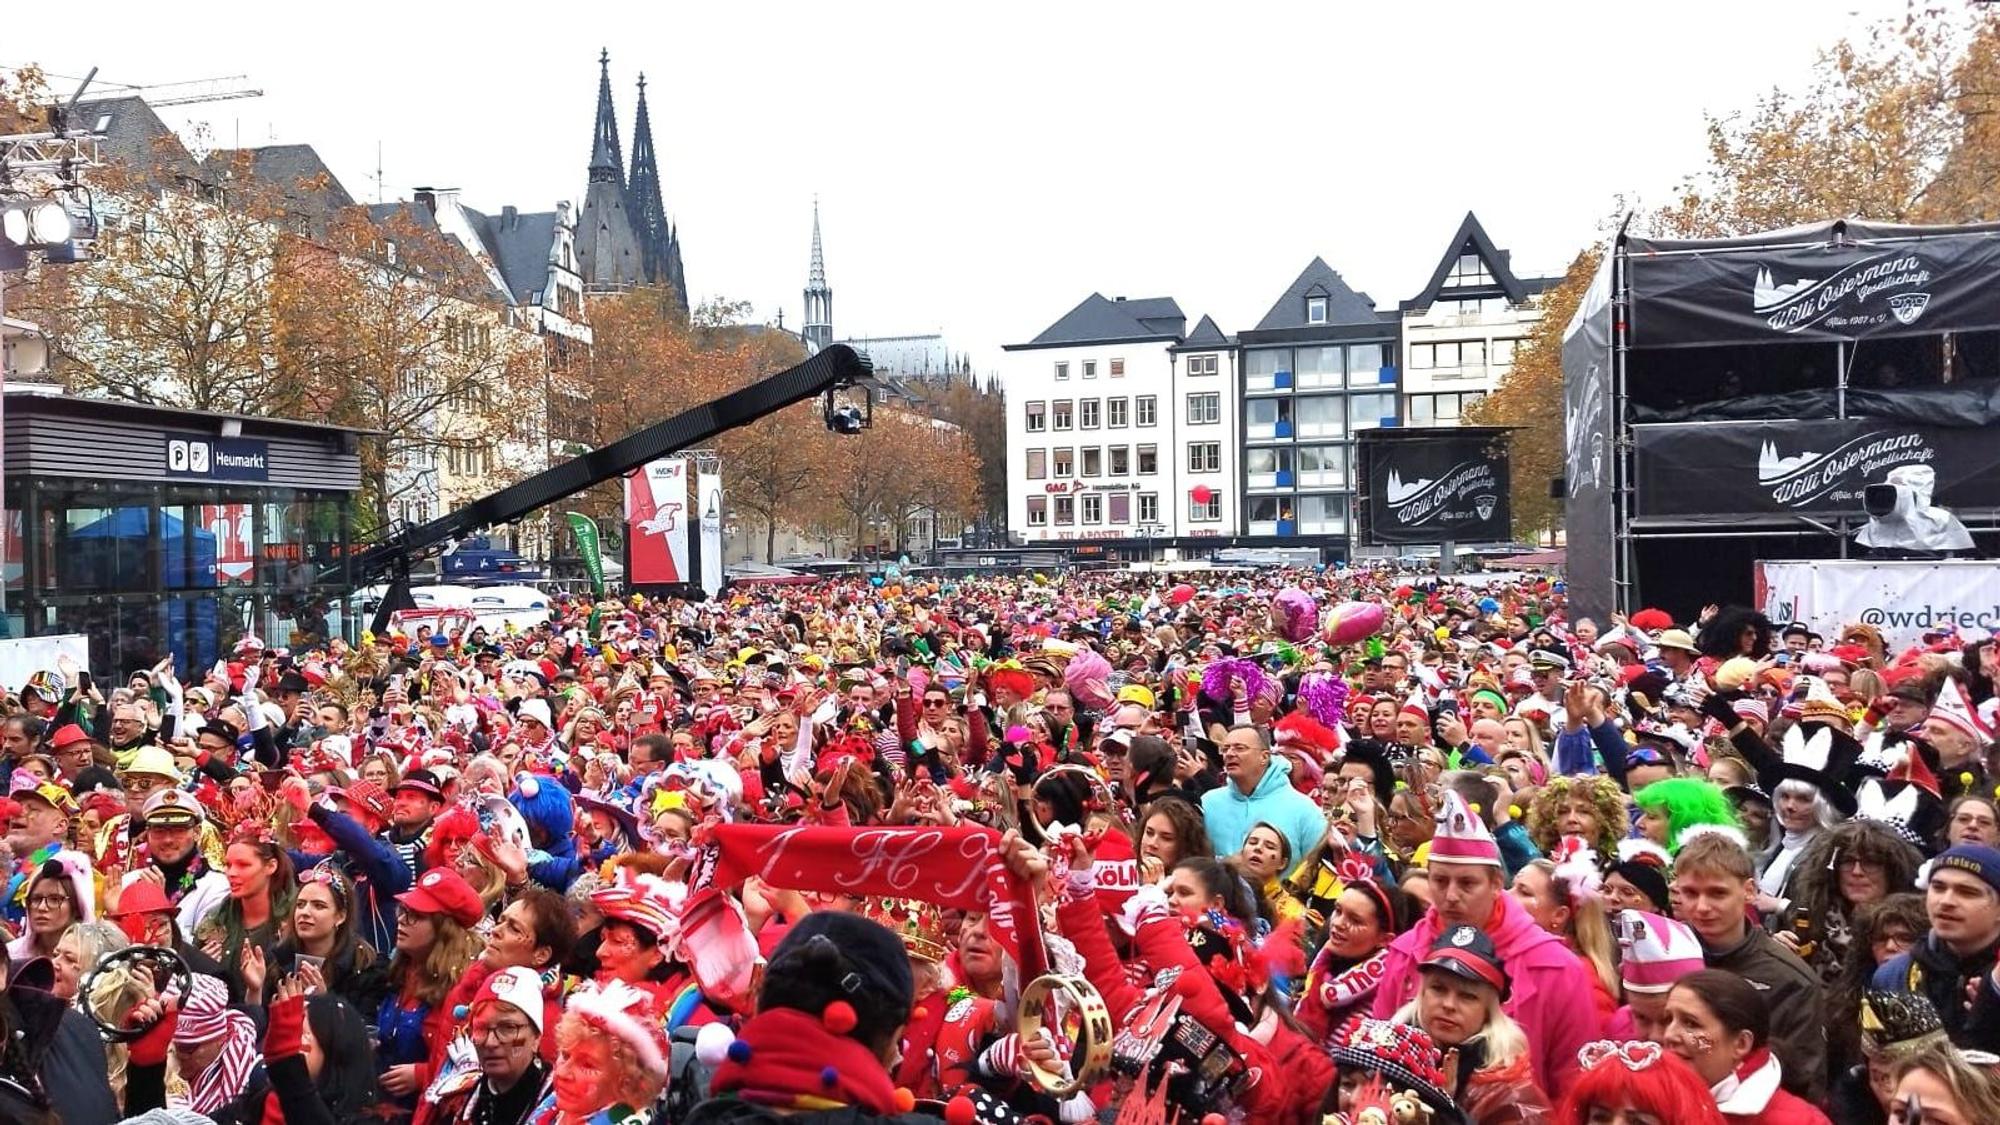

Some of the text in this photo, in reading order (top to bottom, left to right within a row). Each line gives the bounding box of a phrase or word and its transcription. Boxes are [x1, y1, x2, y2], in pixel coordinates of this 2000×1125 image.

[1767, 255, 1920, 330] Willi Ostermann
[1856, 270, 1931, 303] Gesellschaft
[216, 451, 264, 469] Heumarkt
[1772, 432, 1923, 504] Willi Ostermann
[1860, 447, 1935, 477] Gesellschaft
[1045, 482, 1068, 493] GAG
[1397, 496, 1432, 523] Willi
[1190, 528, 1218, 537] HOTEL
